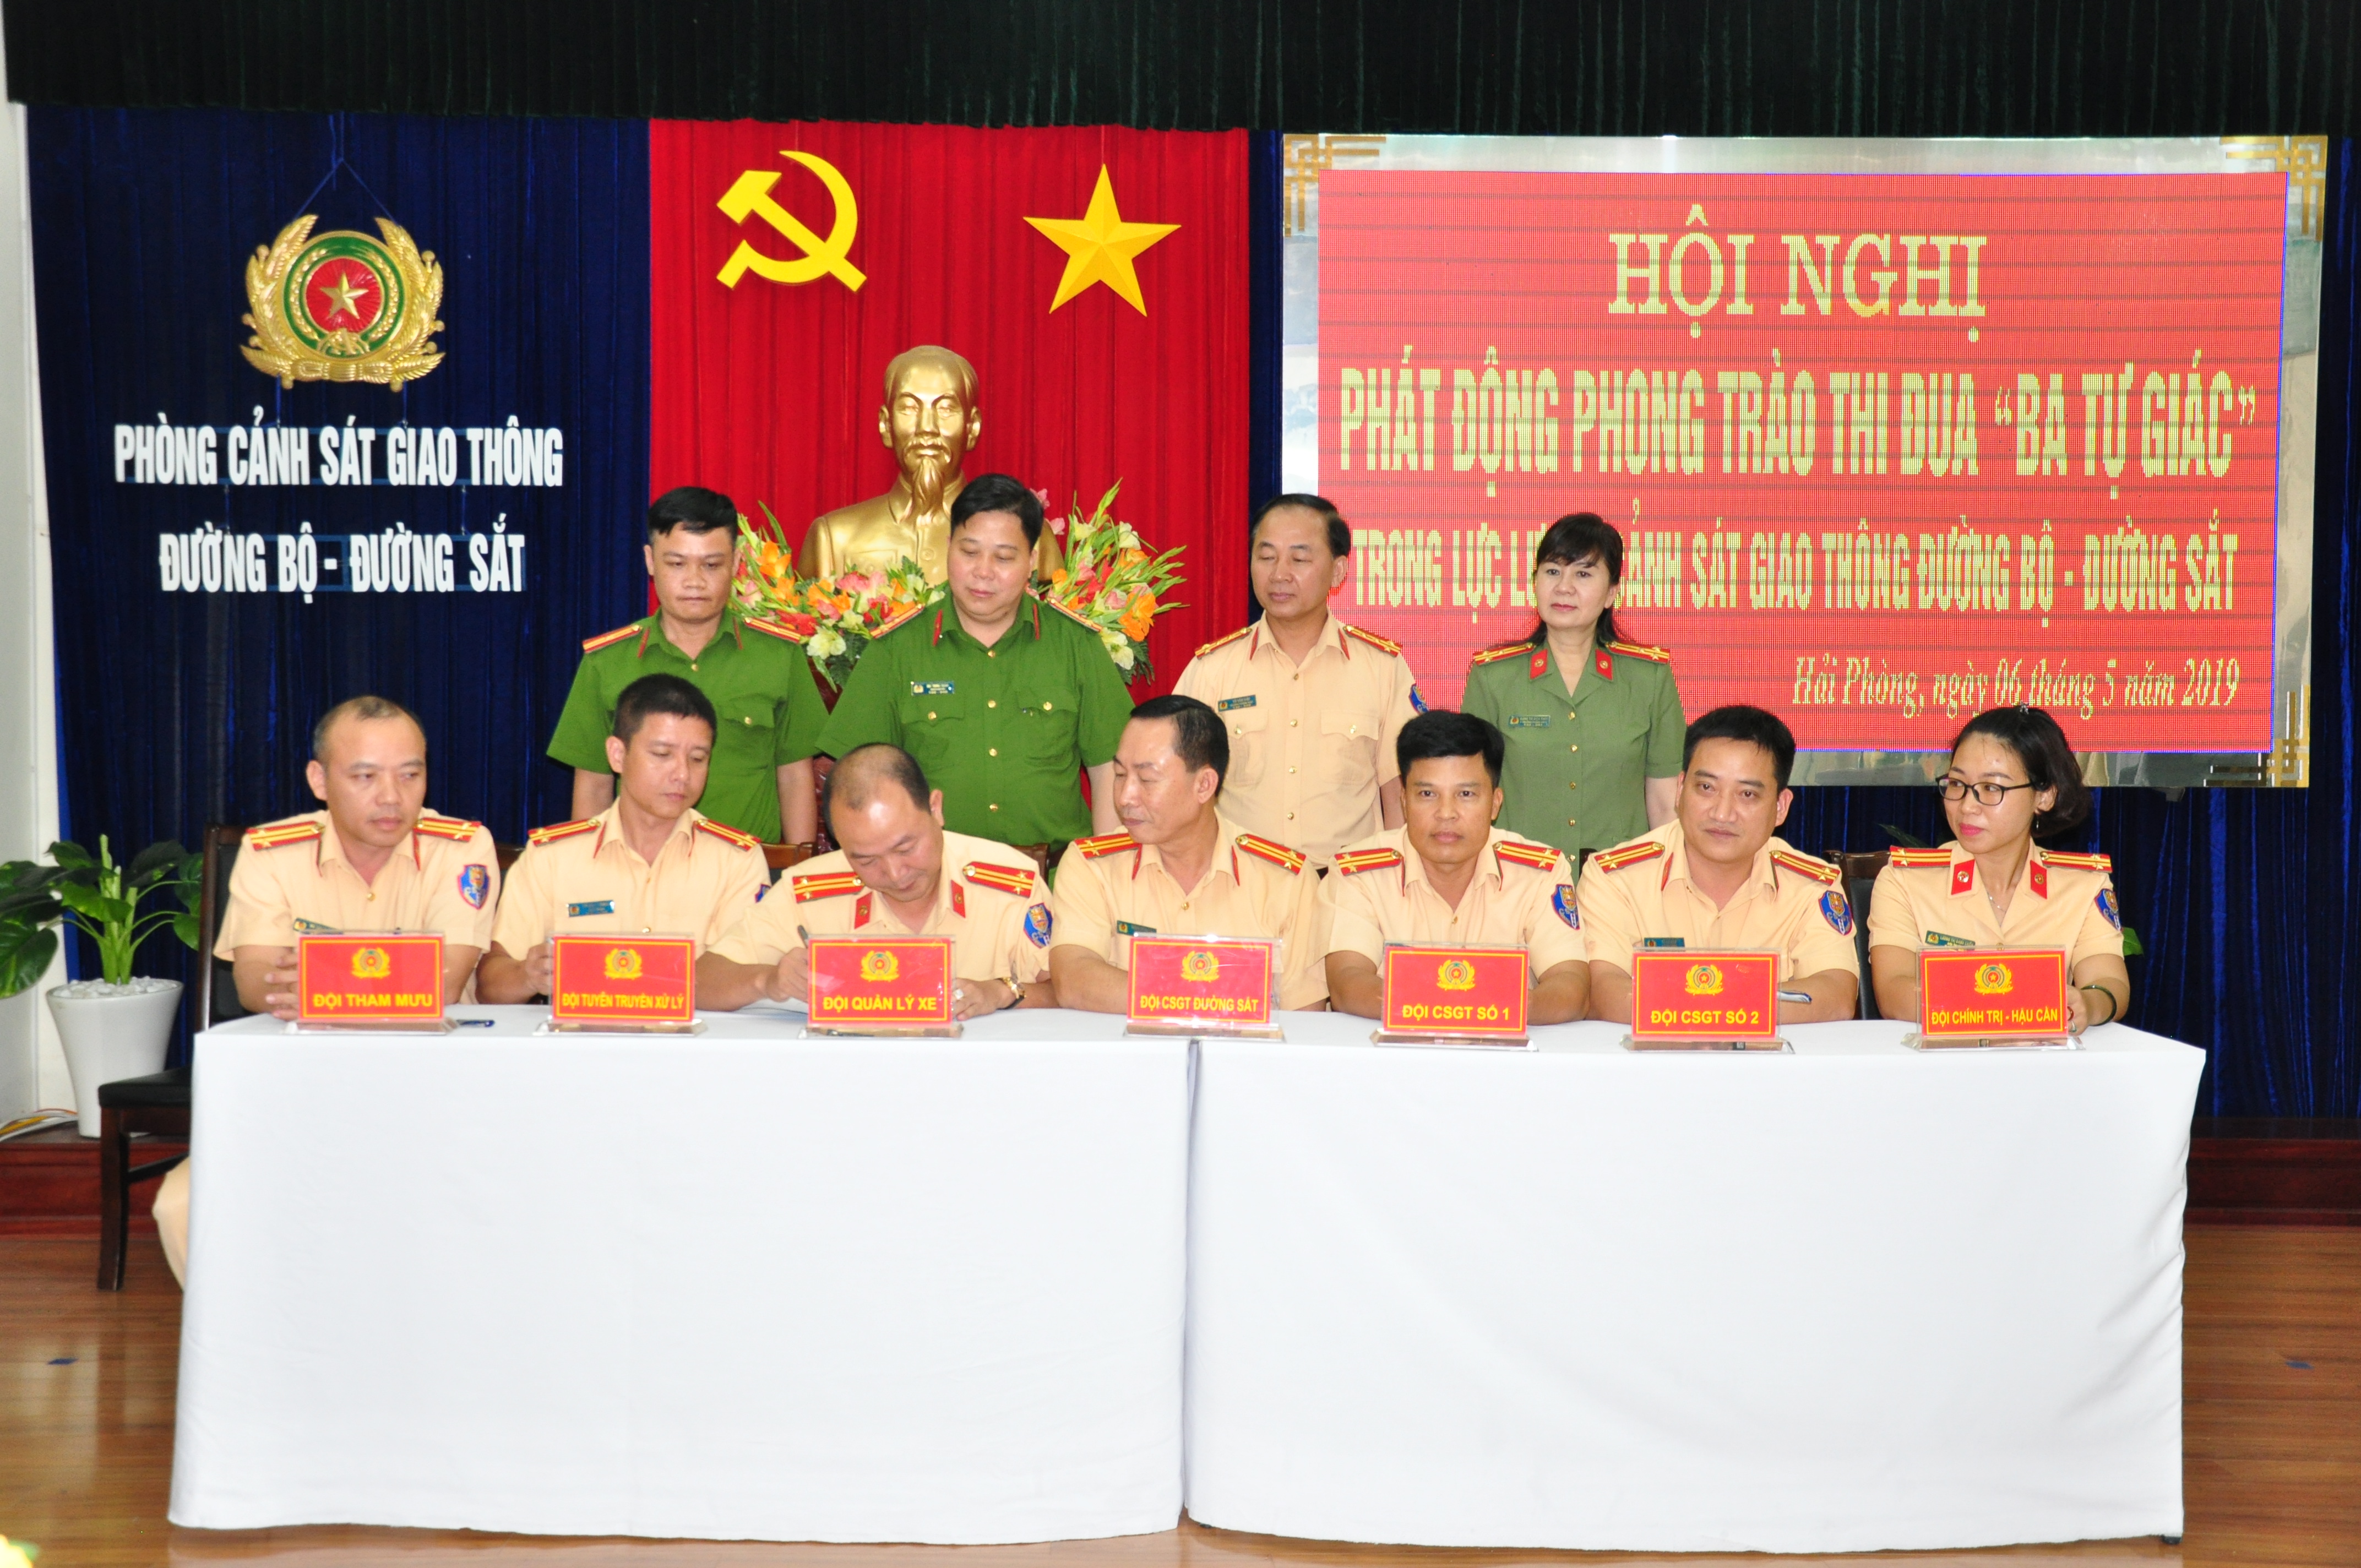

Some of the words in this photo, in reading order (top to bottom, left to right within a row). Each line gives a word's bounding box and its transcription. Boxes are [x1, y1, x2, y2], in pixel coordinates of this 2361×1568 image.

[1608, 204, 1755, 338] HỘI
[1781, 233, 1987, 342] NGHỊ
[1341, 345, 1441, 471] PHÁT
[1452, 346, 1559, 497] ĐỘNG
[1573, 368, 1705, 475] PHONG
[1718, 348, 1816, 476] TRÀO
[1830, 372, 1889, 475] THI
[2082, 362, 2134, 500] TỰ
[115, 412, 218, 485] PHÒNG
[227, 405, 311, 486] CẢNH
[319, 415, 376, 486] SÁT
[387, 427, 458, 486] GIAO
[466, 415, 563, 487] THÔNG
[159, 520, 267, 593] ĐƯỜNG
[277, 521, 317, 604] BỘ
[324, 558, 338, 570] -
[349, 521, 455, 593] ĐƯỜNG
[469, 513, 525, 592] SẮT
[1352, 529, 1442, 608] TRONG
[1452, 522, 1502, 624] LỰC
[1613, 498, 1683, 609] ẢNH
[1690, 516, 1742, 610] SÁT
[1750, 532, 1813, 611] GIAO
[1822, 518, 1911, 611] THÔNG
[1917, 515, 2010, 612] ĐƯỜNG
[2020, 519, 2054, 628] BỘ
[2064, 570, 2074, 587] -
[2083, 515, 2177, 612] ĐƯỜNG
[2185, 508, 2239, 612] SẮT
[1793, 652, 1837, 705] Hải
[1842, 657, 1925, 719] Phòng,
[1933, 660, 1989, 720] ngày
[1994, 658, 2023, 706] 06
[2028, 658, 2096, 720] tháng
[2102, 658, 2118, 706] 5
[2124, 660, 2175, 706] năm
[2181, 657, 2240, 706] 2019
[313, 992, 342, 1010] ĐỘI
[345, 993, 391, 1008] THAM
[395, 993, 433, 1008] MƯU
[562, 992, 580, 1010] ĐỘI
[580, 991, 614, 1008] TUYÊN
[671, 993, 684, 1009] LÝ
[822, 994, 848, 1013] ĐỘI
[851, 994, 894, 1011] QUẢN
[896, 994, 915, 1011] LÝ
[918, 997, 937, 1011] XE
[1140, 994, 1160, 1011] ĐỘI
[1161, 995, 1192, 1010] CSGT
[1193, 994, 1234, 1012] ĐƯỜNG
[1402, 1003, 1429, 1022] ĐỘI
[1432, 1005, 1473, 1020] CSGT
[1477, 1004, 1498, 1021] SỐ
[1502, 1007, 1509, 1021] 1
[1651, 1009, 1677, 1027] ĐỘI
[1681, 1010, 1722, 1024] CSGT
[1726, 1008, 1747, 1025] SỐ
[1750, 1011, 1759, 1025] 2
[1932, 1010, 1950, 1028] ĐỘI
[1952, 1008, 1984, 1024] CHÍNH
[1986, 1010, 2003, 1026] TRỊ
[2011, 1008, 2033, 1026] HẬU
